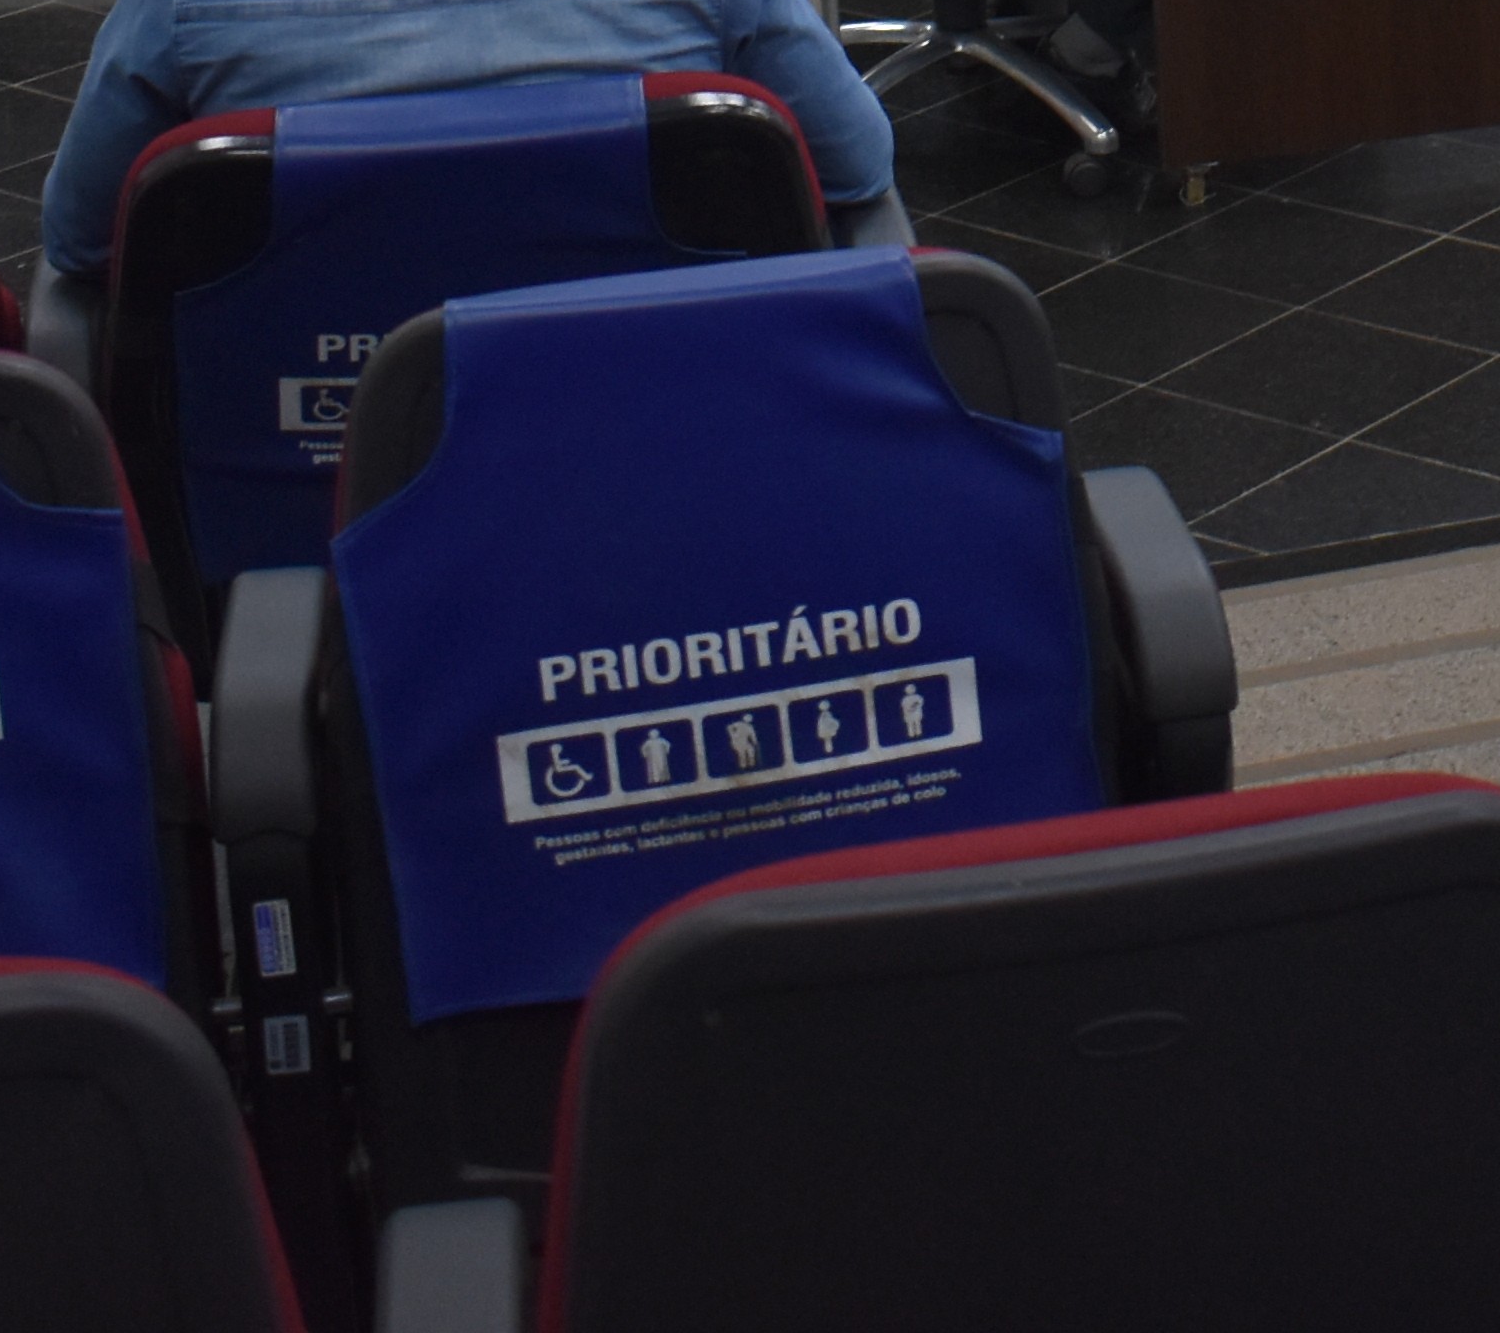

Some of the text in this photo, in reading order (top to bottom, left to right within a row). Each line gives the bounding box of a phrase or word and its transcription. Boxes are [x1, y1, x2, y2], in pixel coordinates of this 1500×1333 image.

[538, 597, 923, 703] PRIORITÁRIO
[534, 831, 600, 850] Pessoas
[603, 825, 638, 839] com
[640, 811, 723, 833] deficiência
[726, 807, 747, 821] ou
[749, 792, 833, 815] mobilidade
[835, 778, 904, 800] reduzida,
[555, 785, 947, 866] gestantes, lactantes e pessoas com crianças de colo
